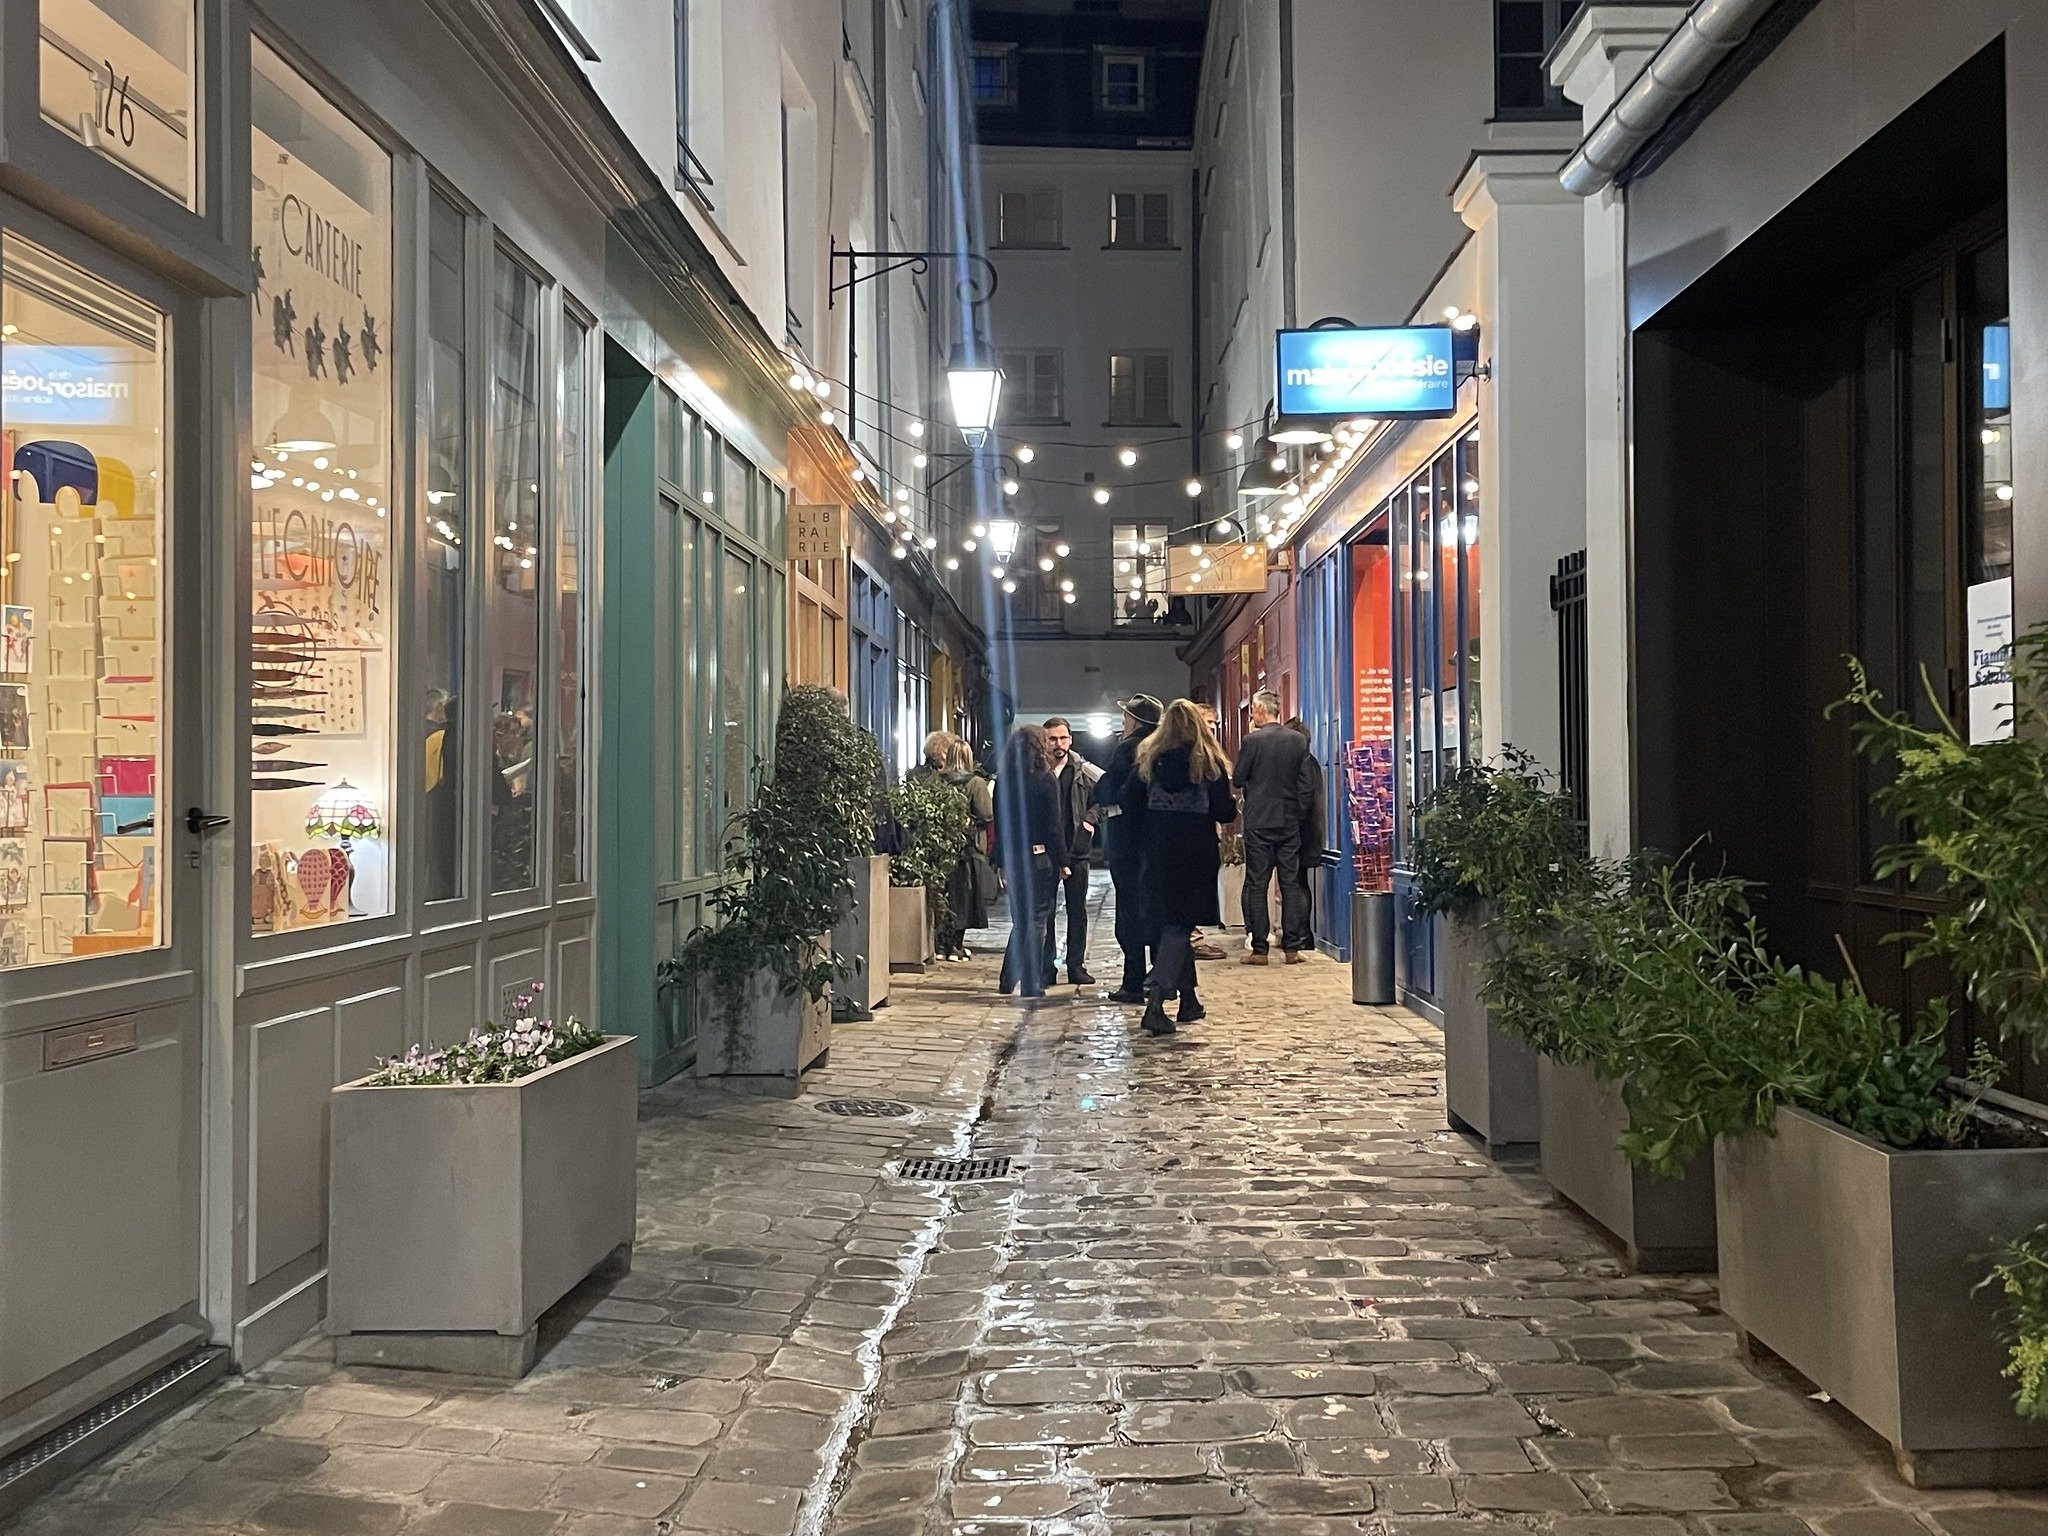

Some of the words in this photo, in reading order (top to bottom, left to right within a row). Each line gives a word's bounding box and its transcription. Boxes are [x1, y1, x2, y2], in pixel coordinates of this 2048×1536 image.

[104, 59, 134, 147] 26
[281, 193, 363, 300] CARTERIE
[798, 512, 830, 523] LIB
[798, 527, 828, 538] RAI
[798, 541, 830, 553] RIE
[311, 610, 339, 632] PARIS
